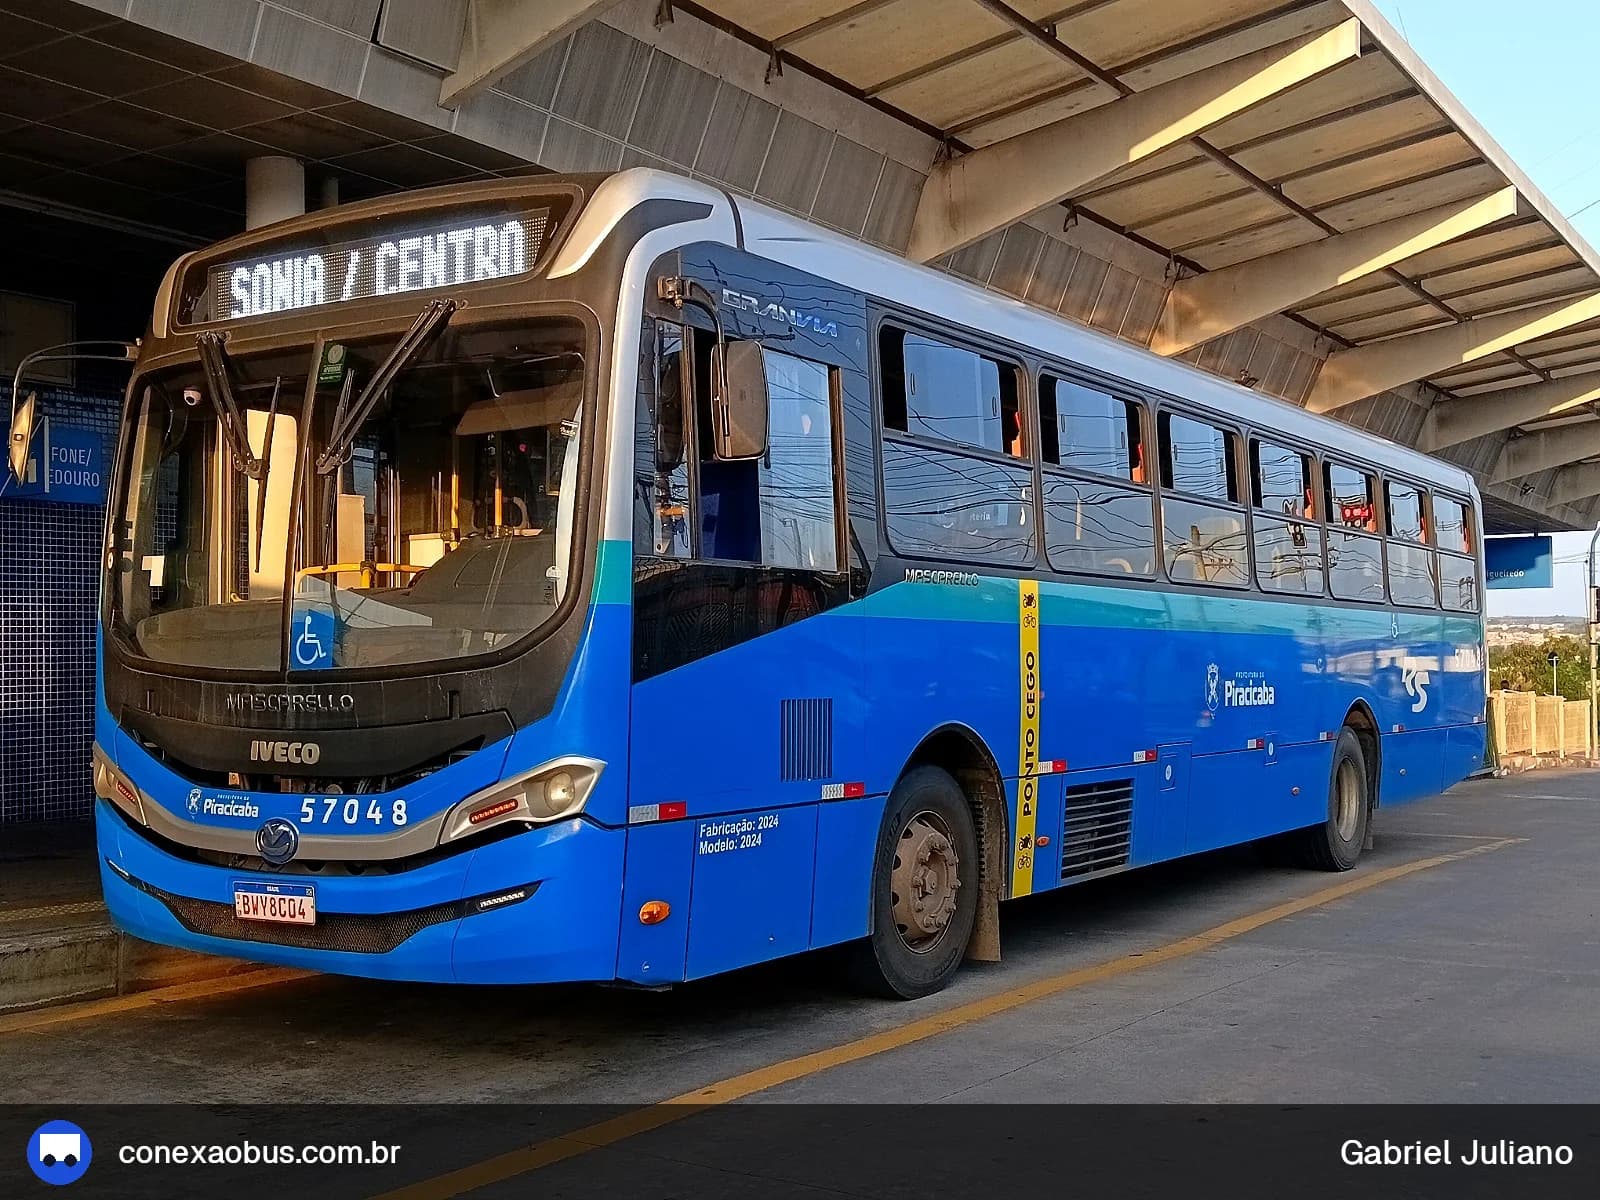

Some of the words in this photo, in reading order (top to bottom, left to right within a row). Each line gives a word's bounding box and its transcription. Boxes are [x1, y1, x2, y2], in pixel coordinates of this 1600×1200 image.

[229, 253, 325, 319] SONIA
[340, 249, 361, 301] /
[375, 219, 526, 296] CENTRO
[722, 287, 838, 338] GRANVIA
[51, 446, 92, 467] FONE/
[904, 568, 979, 587] MASCARELLO
[1026, 651, 1036, 720] CEGO
[1225, 679, 1275, 707] Piracicaba
[226, 693, 354, 713] MASCARELLO
[250, 740, 321, 765] IVECO
[1023, 728, 1036, 817] PONTO
[203, 798, 259, 818] Piracicaba
[300, 797, 408, 826] 57048
[700, 818, 756, 838] Fabricação:
[757, 813, 779, 831] 2024
[699, 837, 738, 856] Modelo:
[740, 833, 762, 849] 2024
